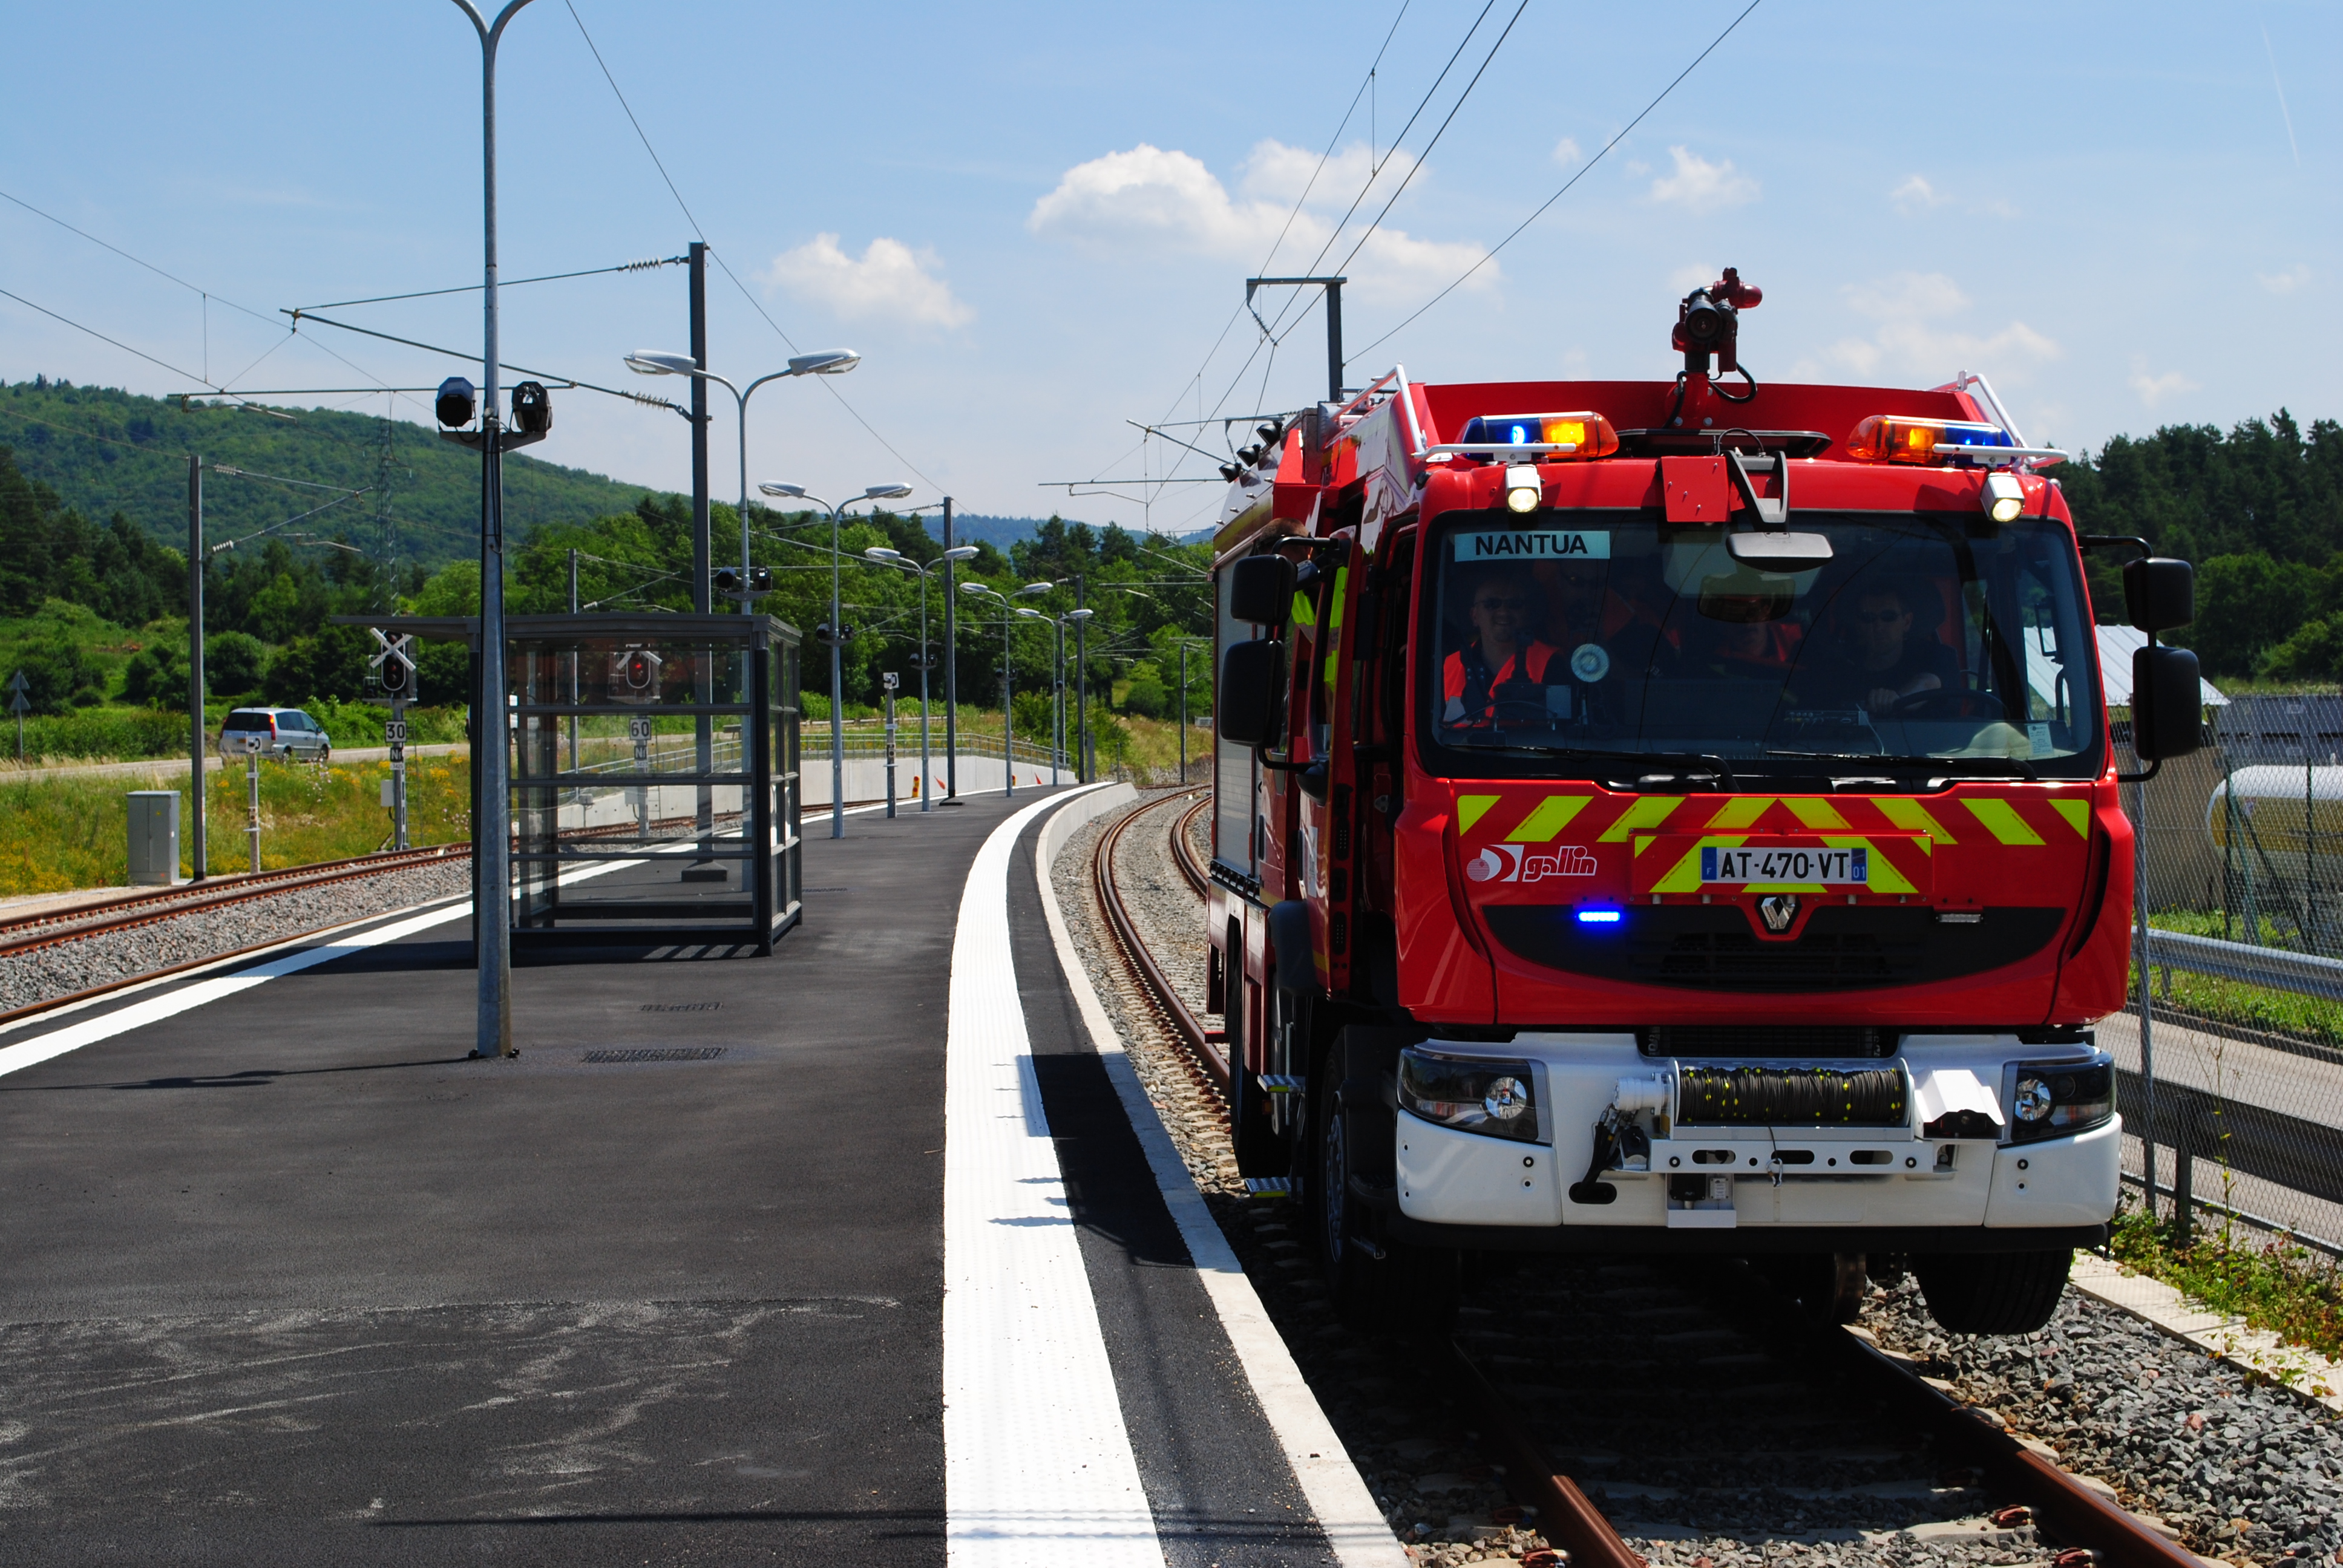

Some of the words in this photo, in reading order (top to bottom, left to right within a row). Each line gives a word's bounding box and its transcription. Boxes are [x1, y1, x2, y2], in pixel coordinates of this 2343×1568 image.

[1475, 534, 1588, 555] NANTUA
[387, 724, 405, 739] 30
[631, 721, 649, 737] 60
[1521, 845, 1598, 883] gallin
[1720, 852, 1849, 879] AT-470-VT
[1853, 866, 1866, 879] 01
